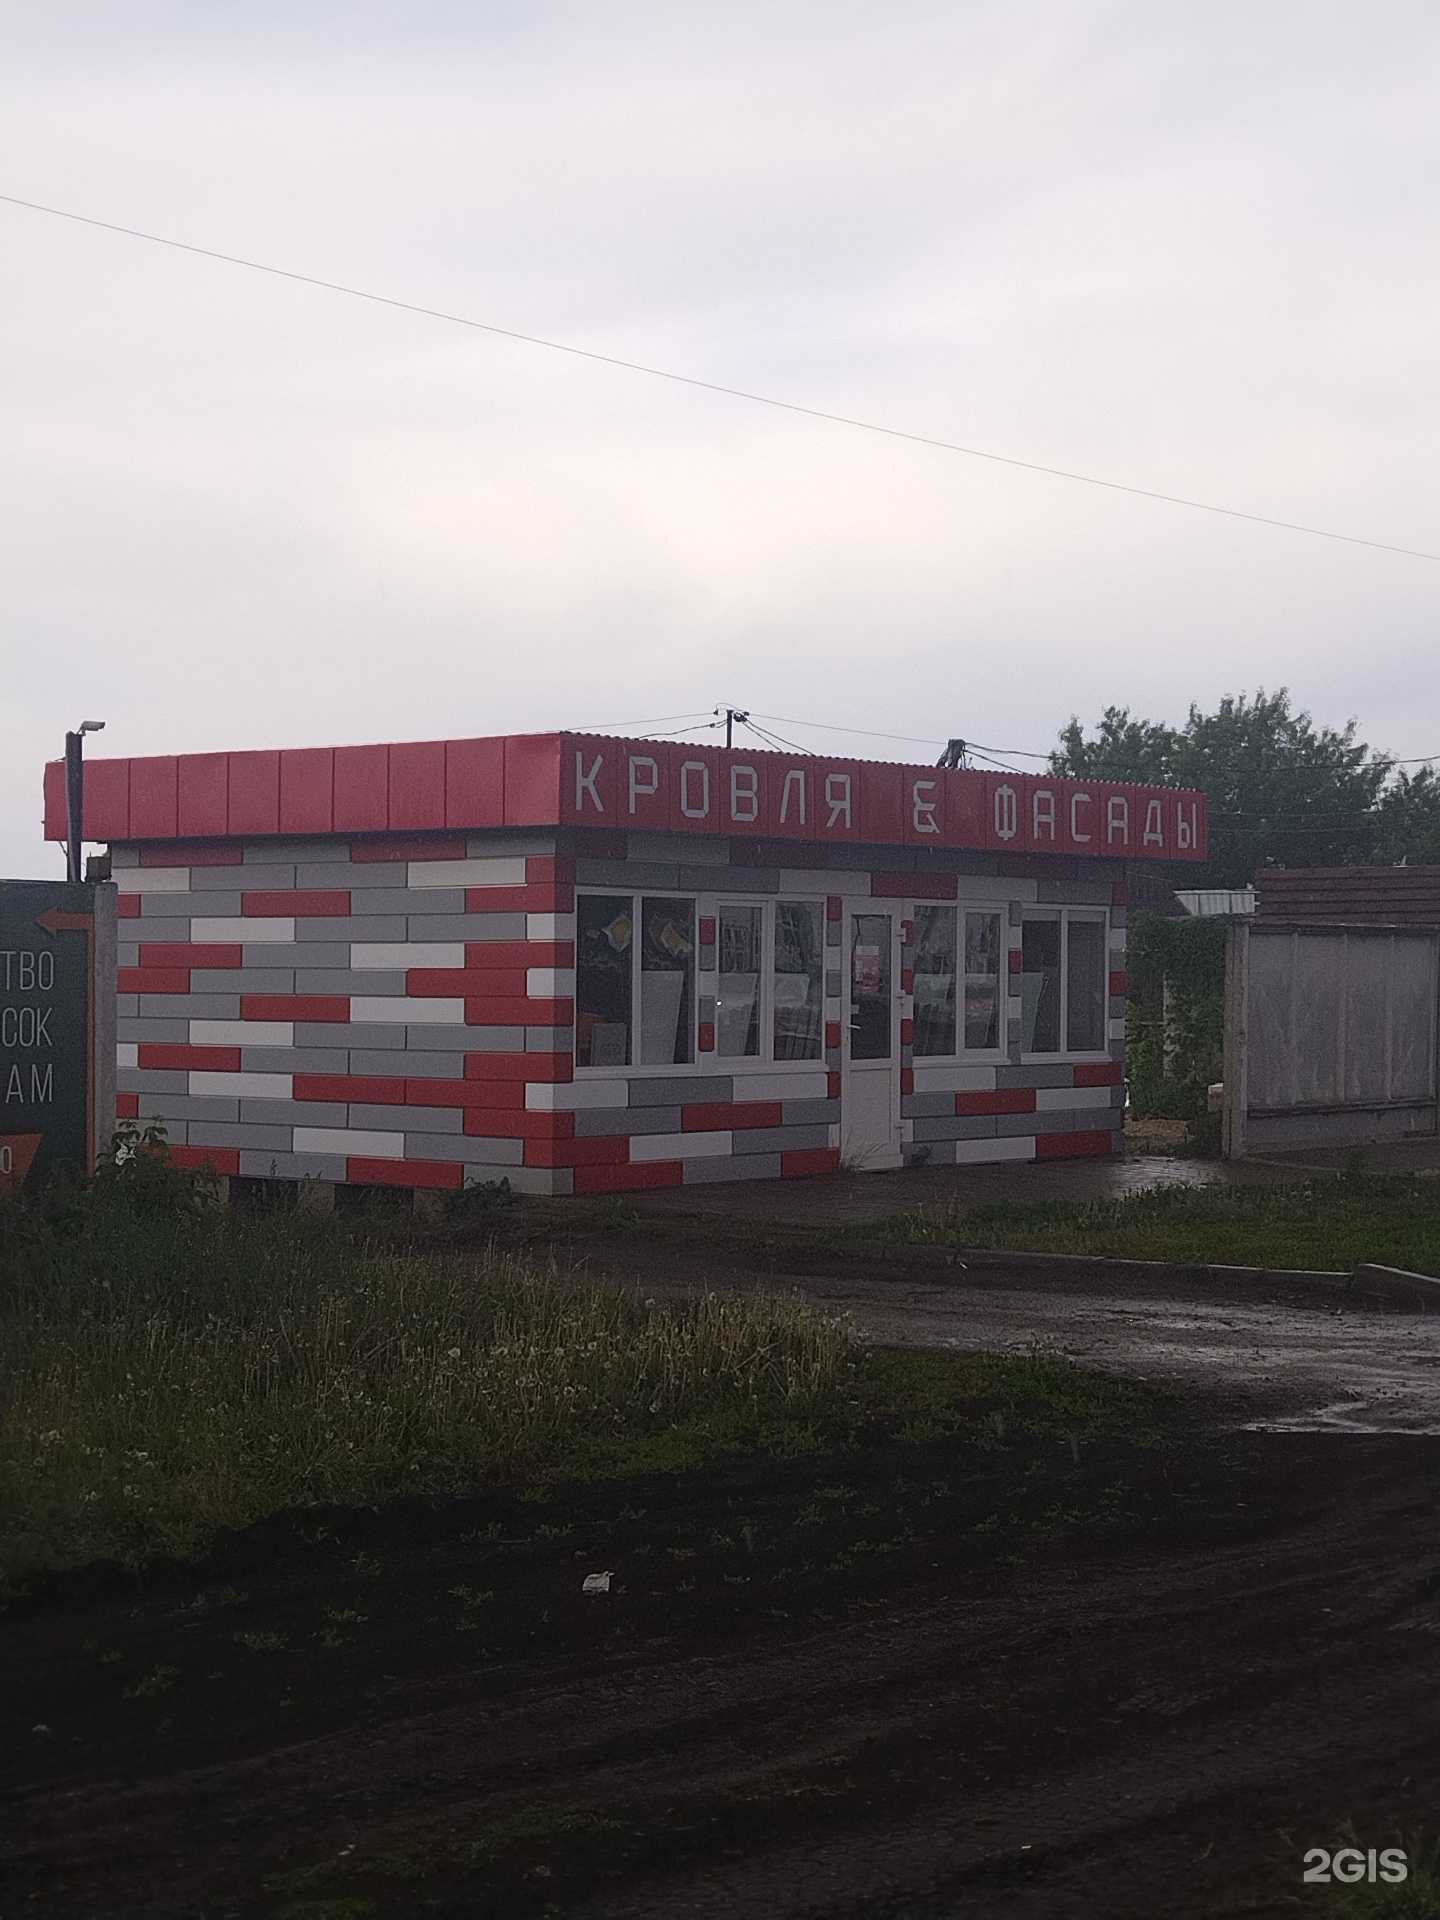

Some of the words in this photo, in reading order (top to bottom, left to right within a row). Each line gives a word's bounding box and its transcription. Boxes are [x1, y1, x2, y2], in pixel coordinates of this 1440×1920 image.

[575, 751, 851, 829] КРОВЛЯ
[993, 783, 1197, 850] ФАСАДЫ
[2, 1007, 53, 1047] СОК
